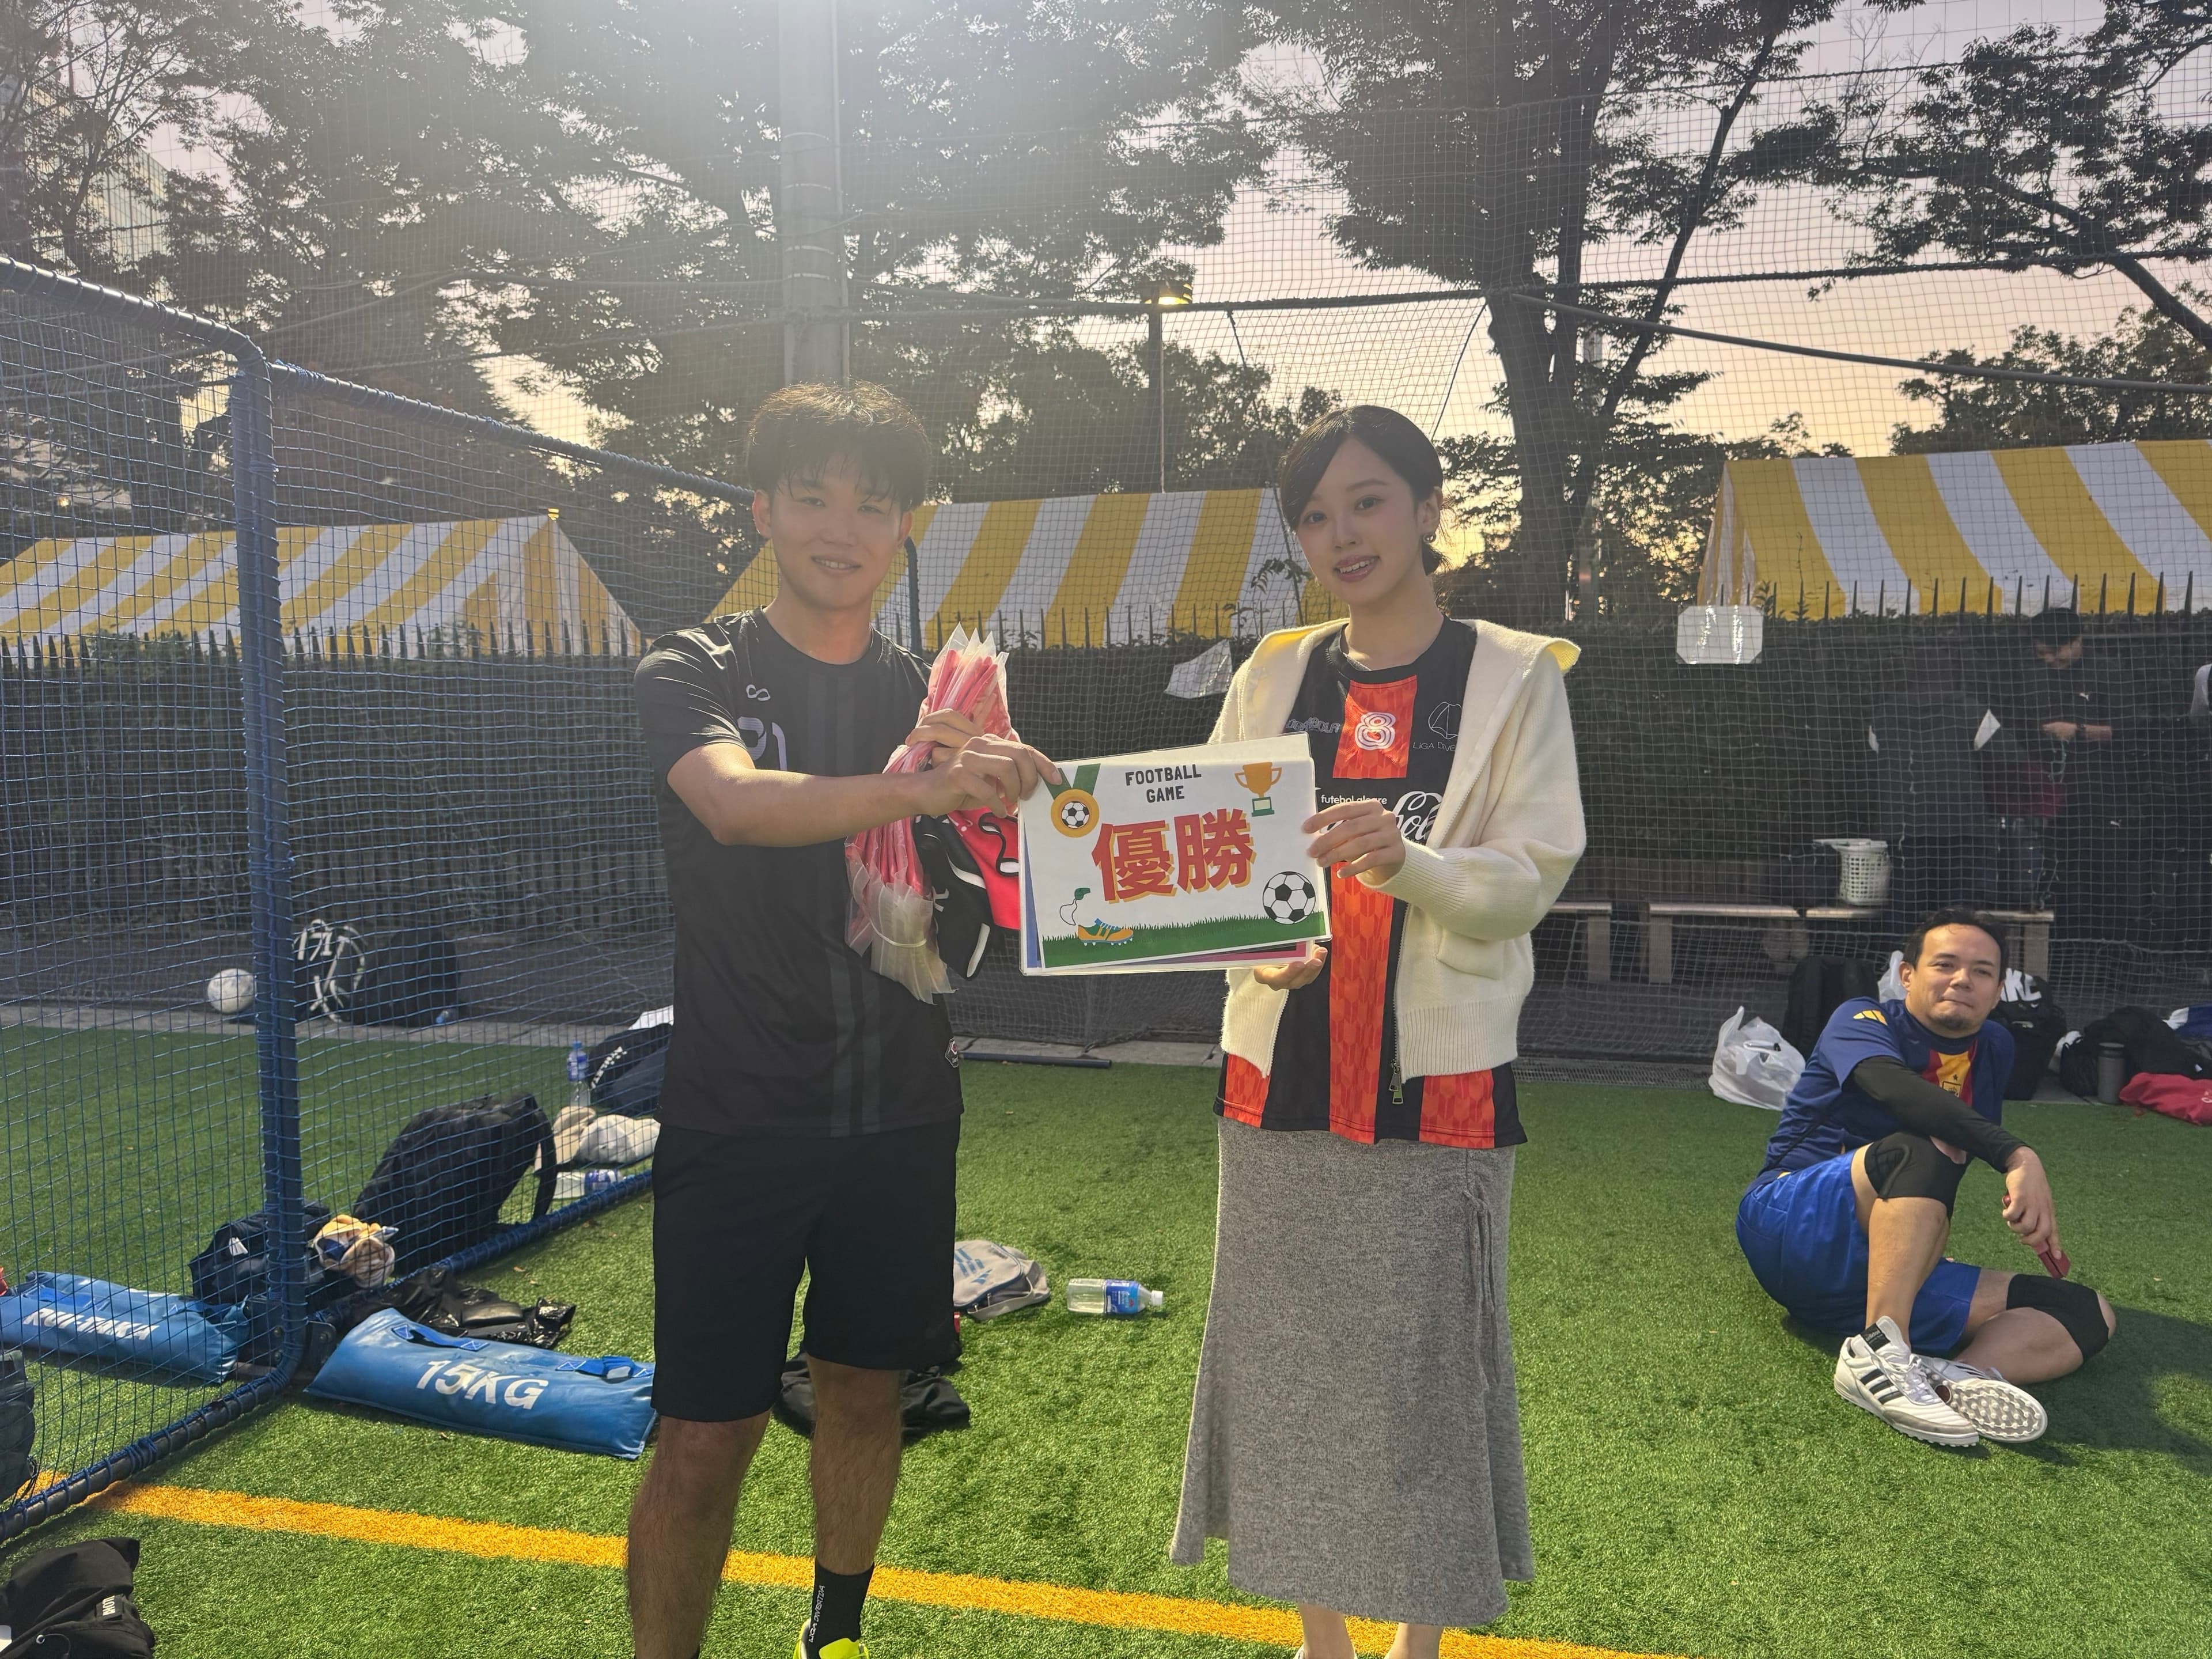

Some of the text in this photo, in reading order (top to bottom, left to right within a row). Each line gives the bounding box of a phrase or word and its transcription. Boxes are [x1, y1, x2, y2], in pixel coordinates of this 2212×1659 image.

[1125, 764, 1202, 786] FOOTBALL
[1146, 785, 1185, 803] GAME
[1321, 794, 1354, 804] futebol
[1091, 808, 1256, 904] 優勝
[416, 1360, 549, 1410] 15KG
